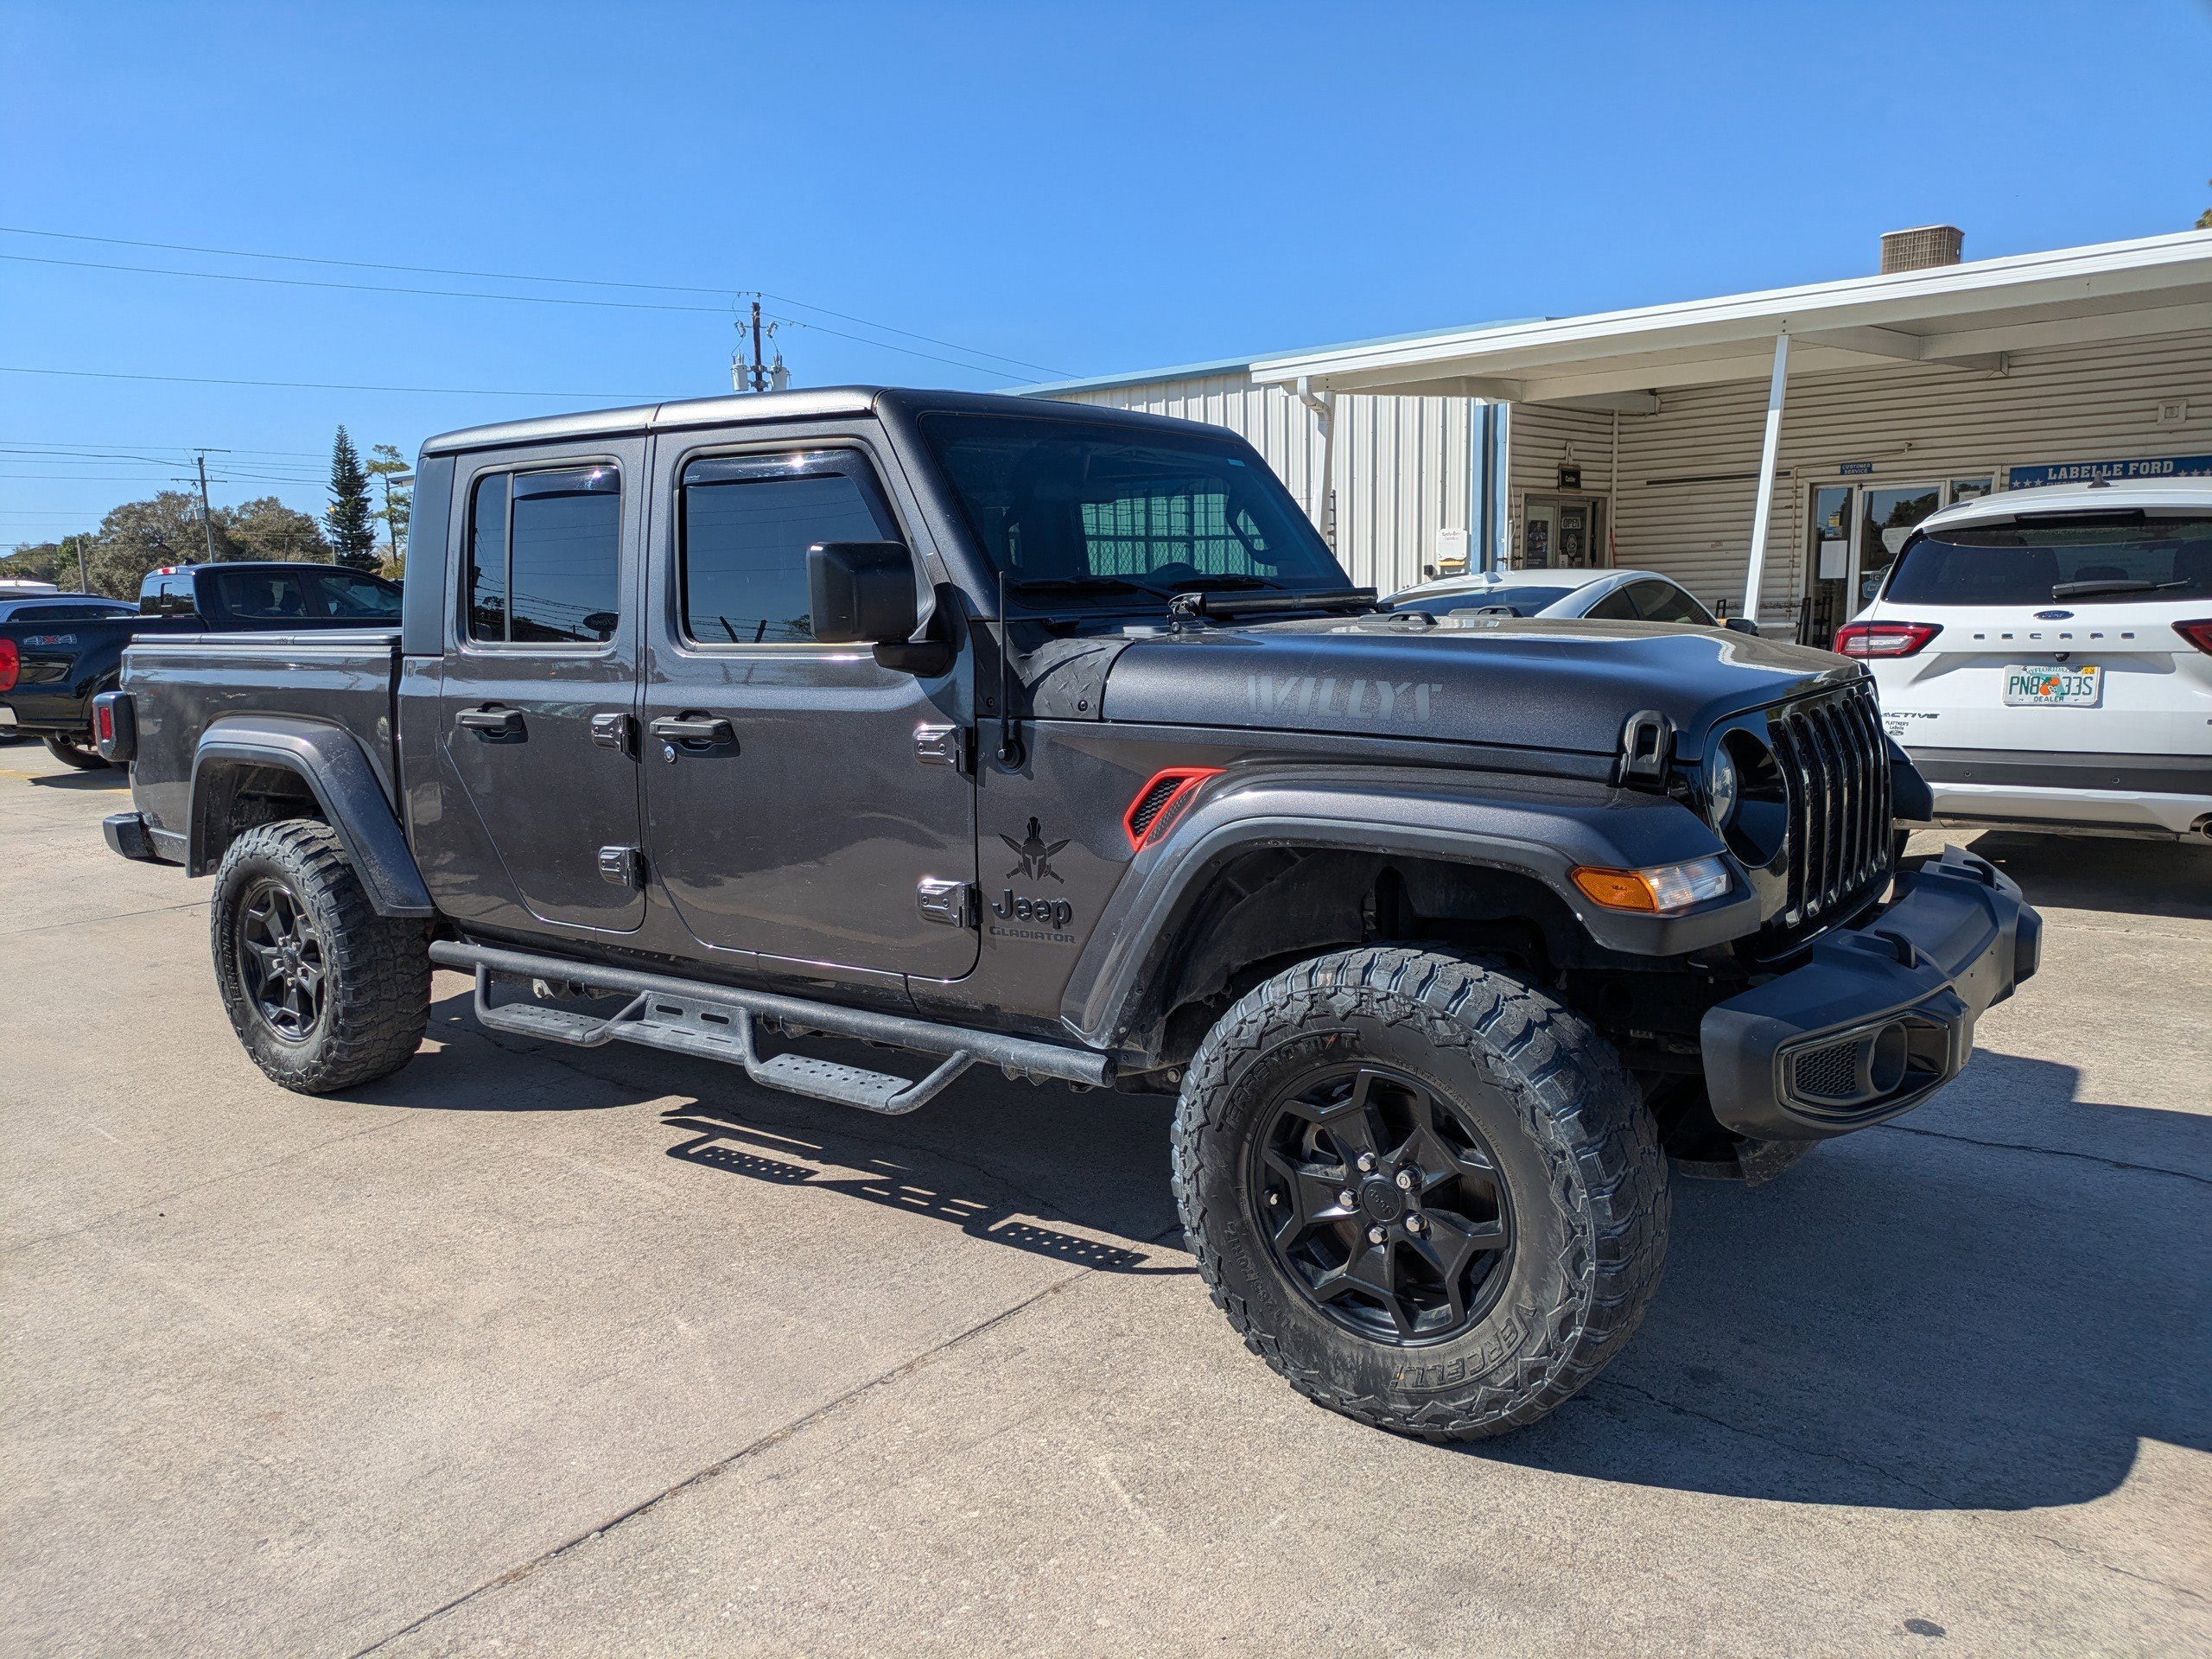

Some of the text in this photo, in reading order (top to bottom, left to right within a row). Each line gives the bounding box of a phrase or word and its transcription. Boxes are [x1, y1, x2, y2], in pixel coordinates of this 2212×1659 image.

[2048, 461, 2174, 480] LABELLE FORD
[1563, 518, 1580, 528] OPEN
[1973, 632, 2136, 640] ESCAPE
[2008, 676, 2094, 696] PN8 33S
[1247, 675, 1444, 723] WILLYS
[1881, 711, 1941, 720] ACTIVE
[992, 887, 1073, 930] Jeep
[988, 925, 1077, 944] GLADIATOR
